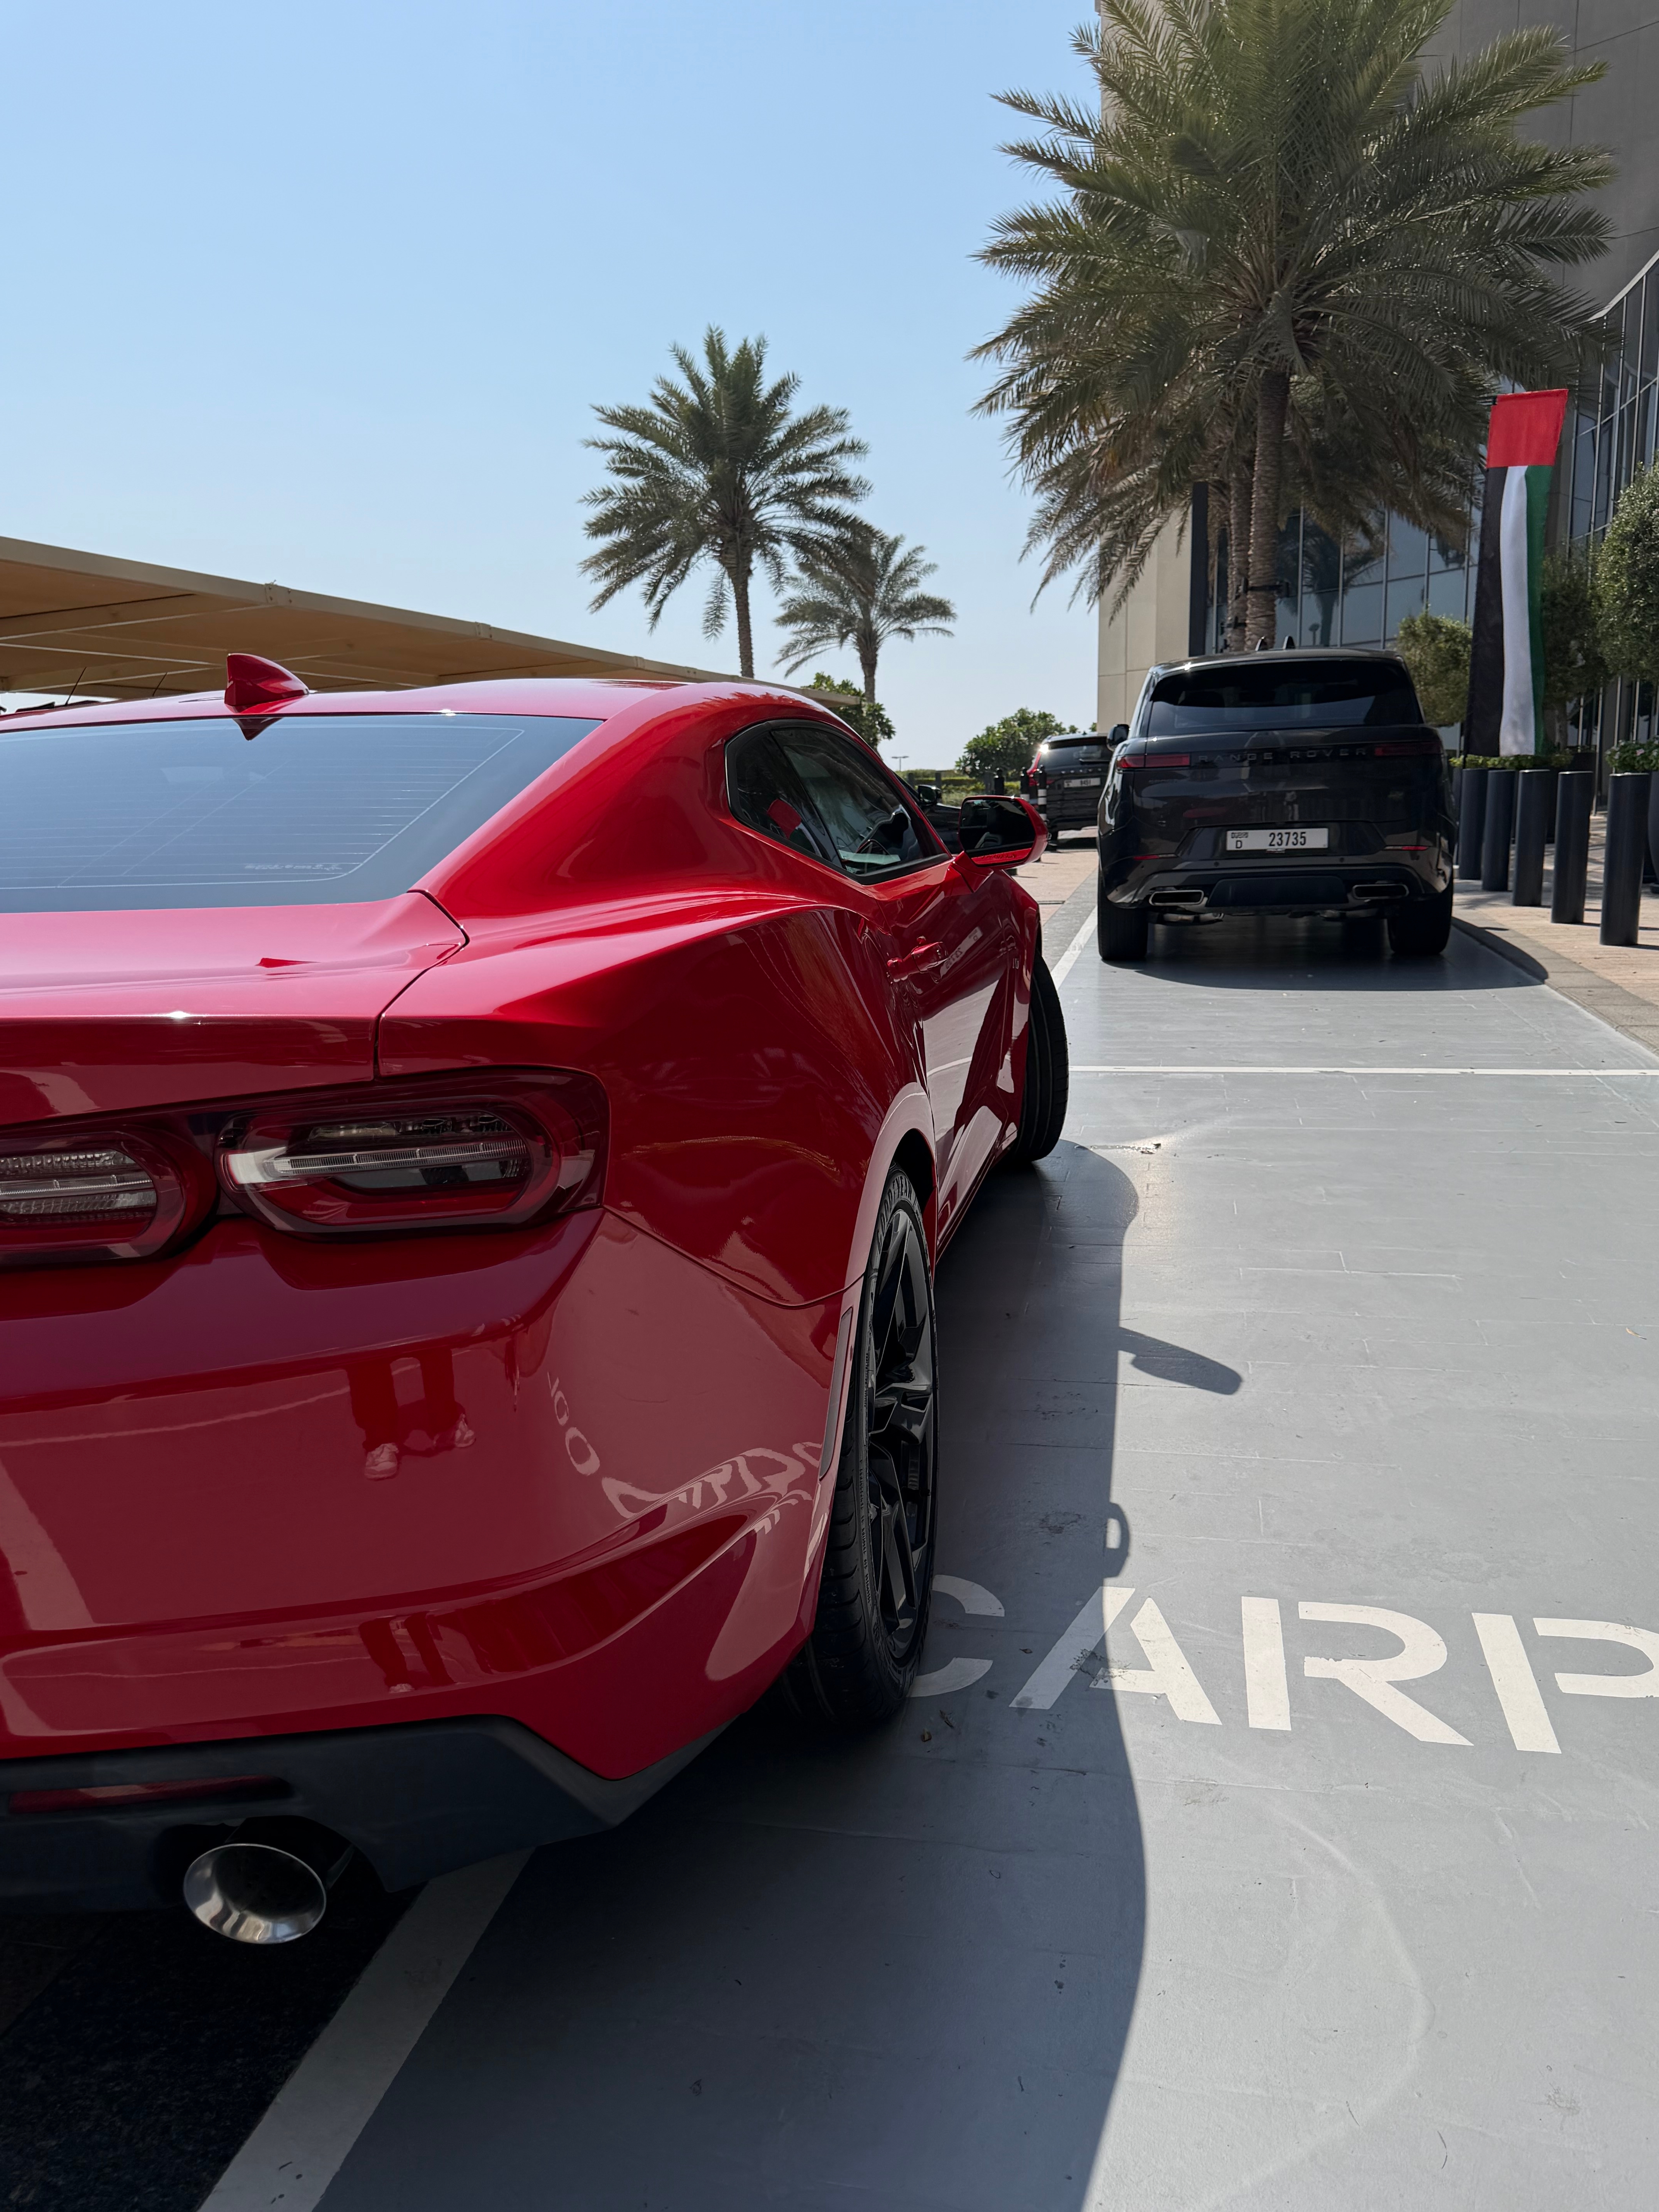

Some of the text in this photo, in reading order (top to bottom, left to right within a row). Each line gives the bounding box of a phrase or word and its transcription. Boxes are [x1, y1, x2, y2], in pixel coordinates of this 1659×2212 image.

[1198, 748, 1367, 762] RANGE ROVER
[1235, 840, 1243, 849] D
[1268, 831, 1307, 847] 23735
